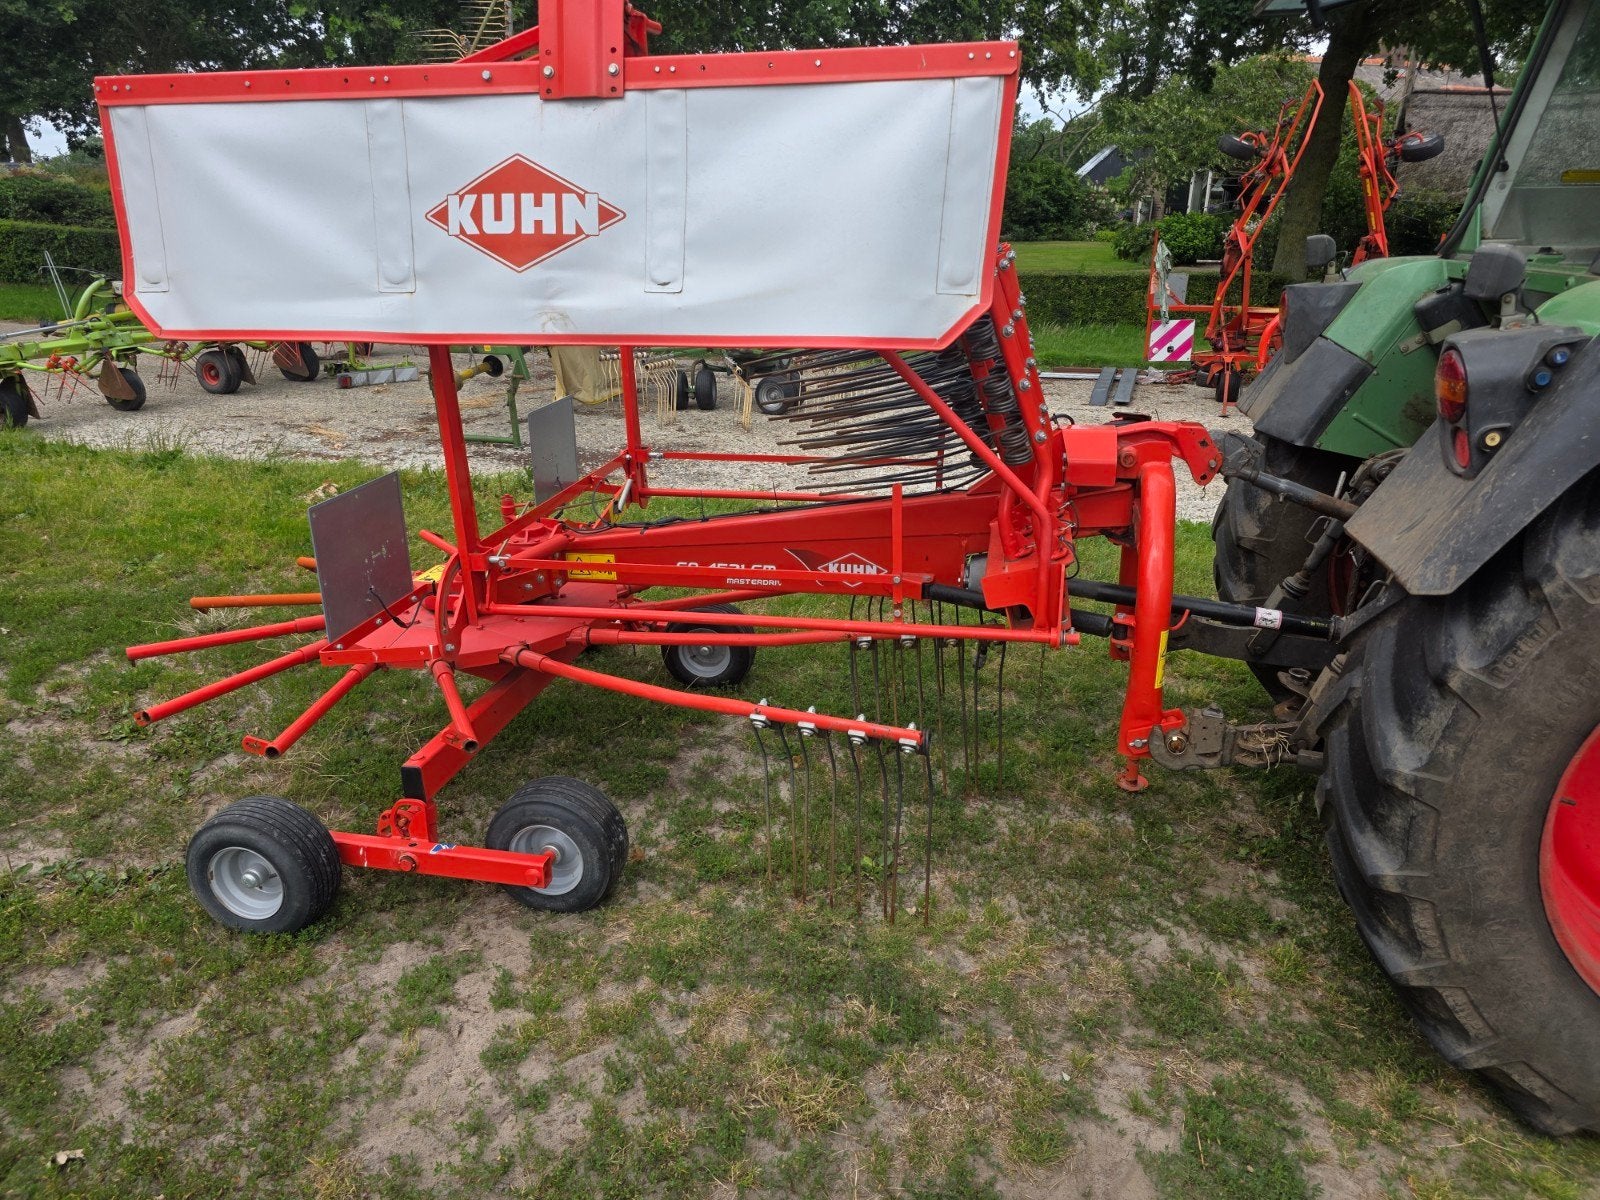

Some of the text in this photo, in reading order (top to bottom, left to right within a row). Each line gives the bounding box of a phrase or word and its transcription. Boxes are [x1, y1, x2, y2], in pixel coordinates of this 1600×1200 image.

[447, 192, 600, 236] KUHN
[828, 562, 877, 575] KUHN
[726, 578, 782, 586] MASTERDRIV
